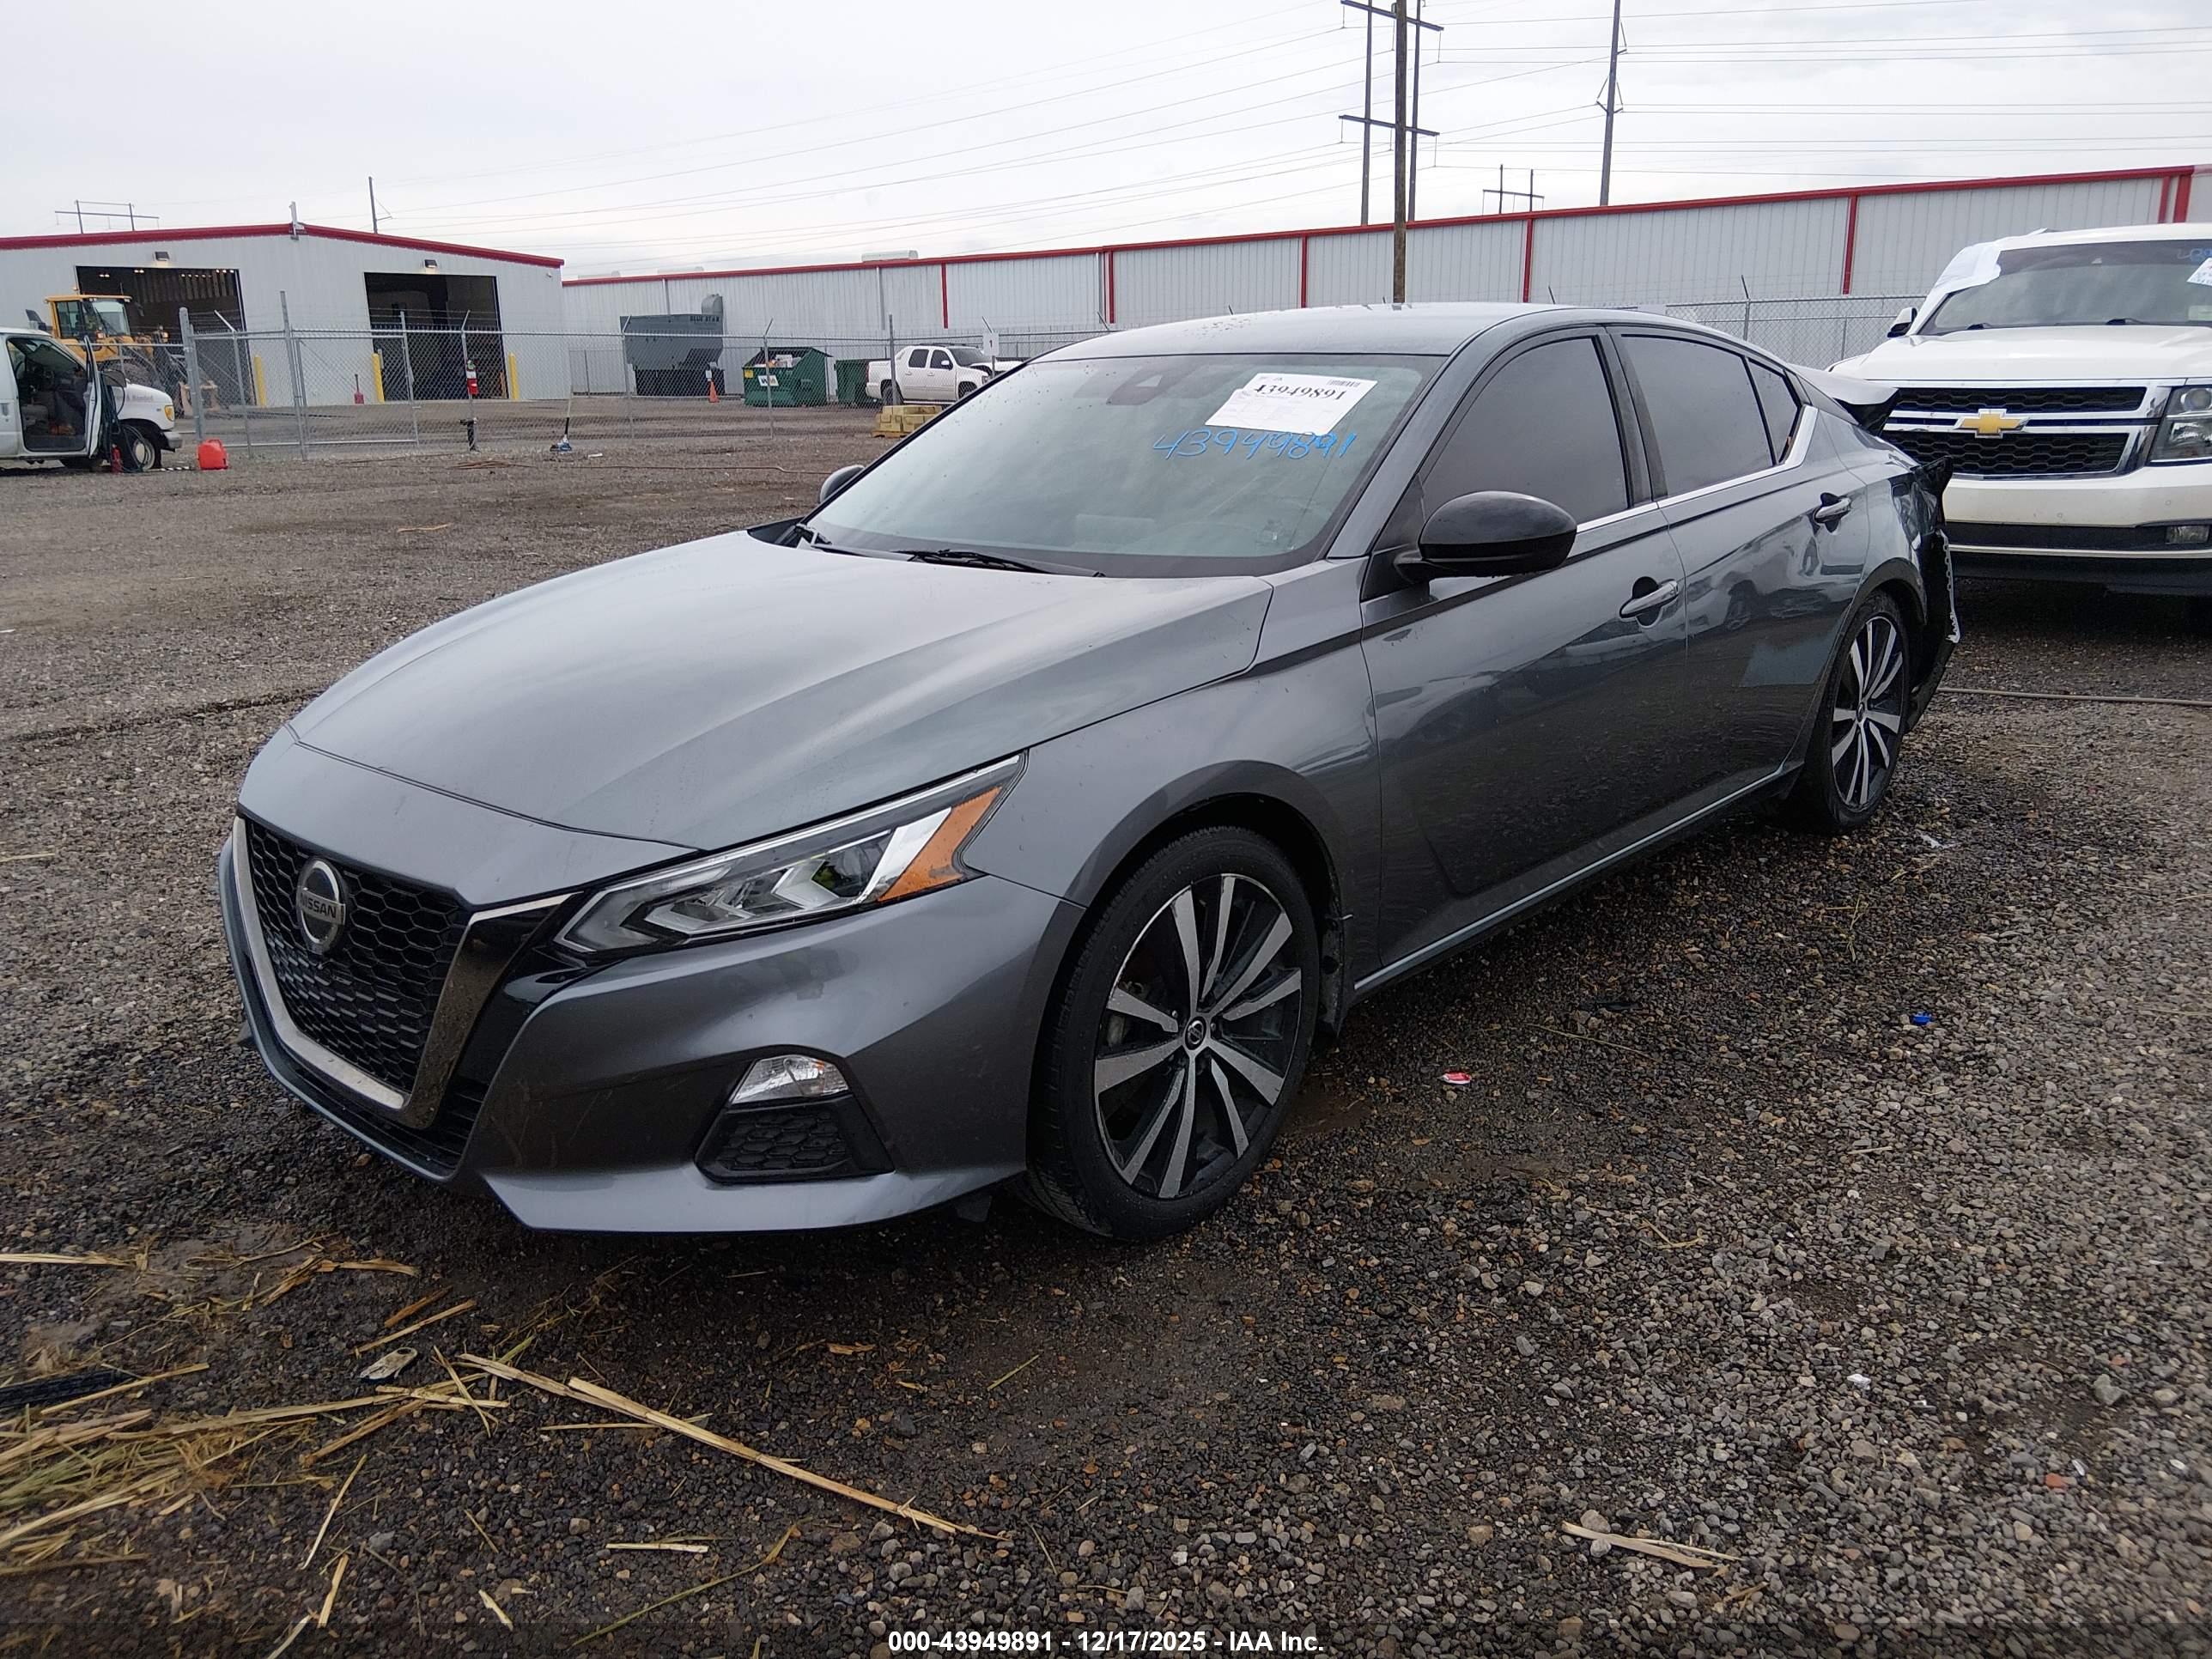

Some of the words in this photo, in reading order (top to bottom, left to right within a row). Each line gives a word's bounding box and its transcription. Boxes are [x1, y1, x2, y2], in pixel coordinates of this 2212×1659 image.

[1255, 384, 1347, 400] 43949891
[1153, 429, 1358, 459] 43949891
[301, 896, 337, 918] NISSAN
